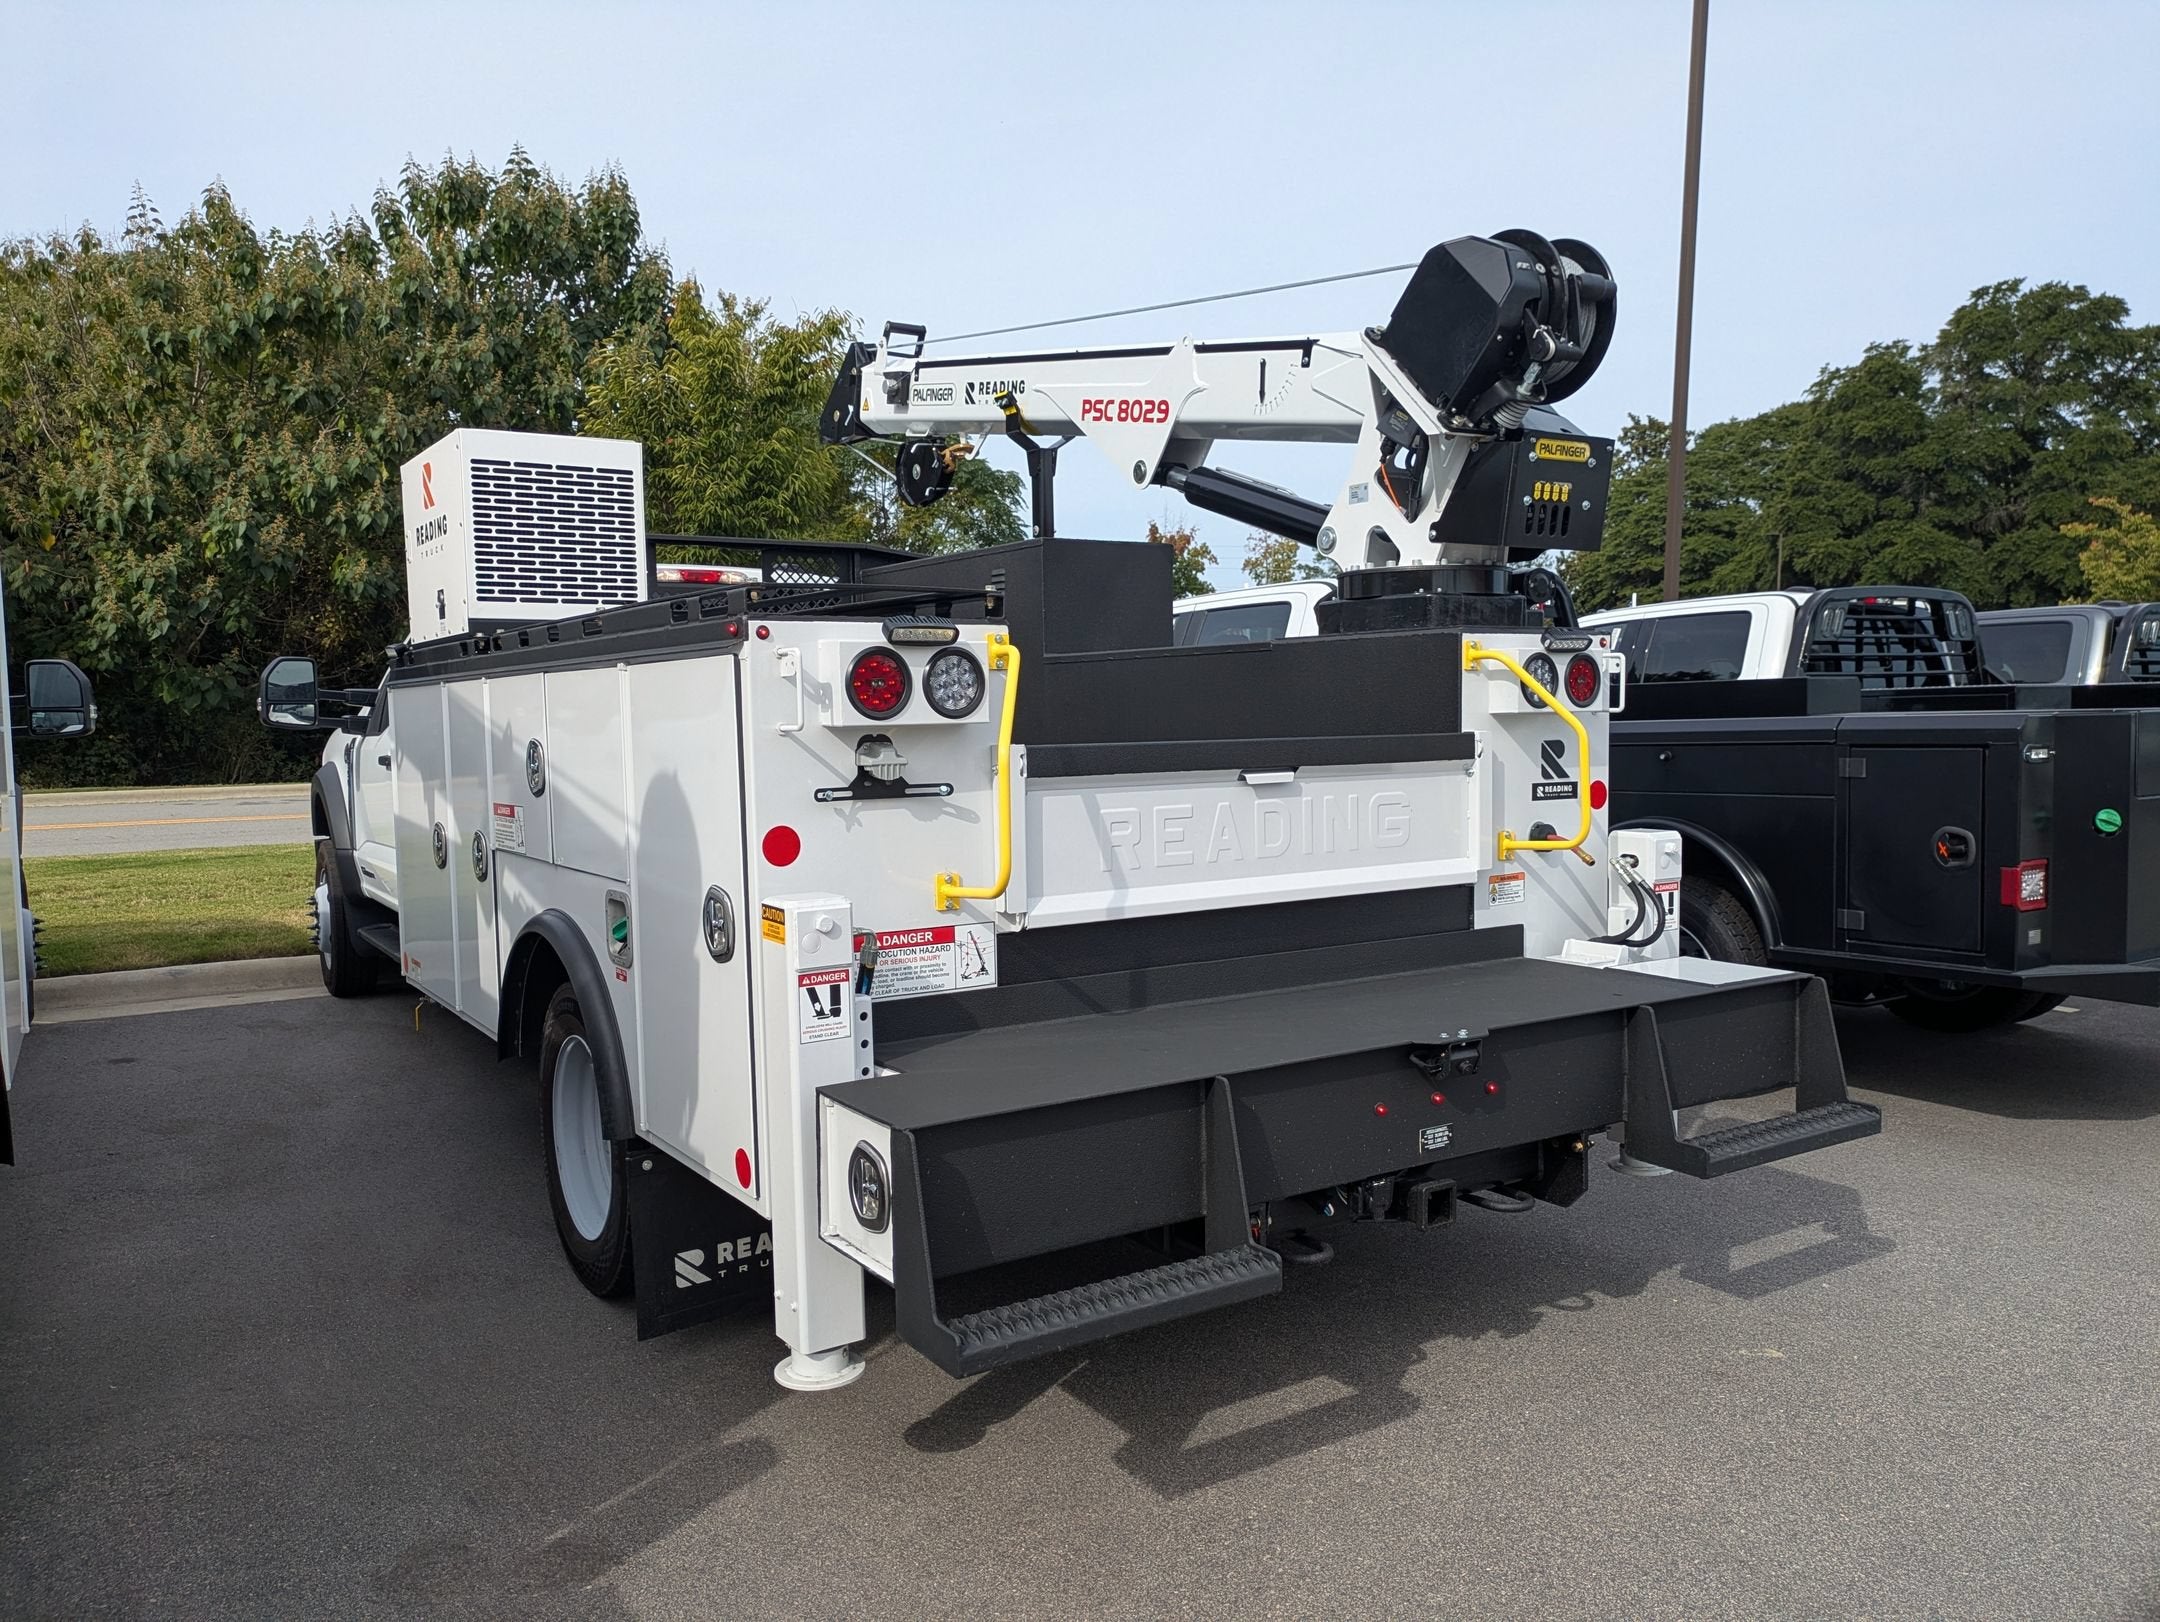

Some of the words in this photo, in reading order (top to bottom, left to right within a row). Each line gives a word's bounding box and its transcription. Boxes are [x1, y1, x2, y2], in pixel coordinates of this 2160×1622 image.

[912, 387, 953, 402] PALFINGER
[978, 380, 1025, 395] READING
[1081, 399, 1115, 421] PSC
[1117, 399, 1169, 423] 8029
[1539, 443, 1586, 458] PALFINGER
[416, 514, 447, 547] READING
[1545, 785, 1573, 793] READING
[1100, 791, 1410, 872] READING
[762, 906, 784, 923] CAUTION
[882, 931, 933, 946] DANGER
[919, 944, 951, 955] HAZARD
[879, 959, 889, 967] OR
[890, 956, 918, 965] SERIOUS
[919, 954, 941, 963] INJURY
[811, 972, 846, 983] DANGER
[718, 1259, 769, 1278] TRU
